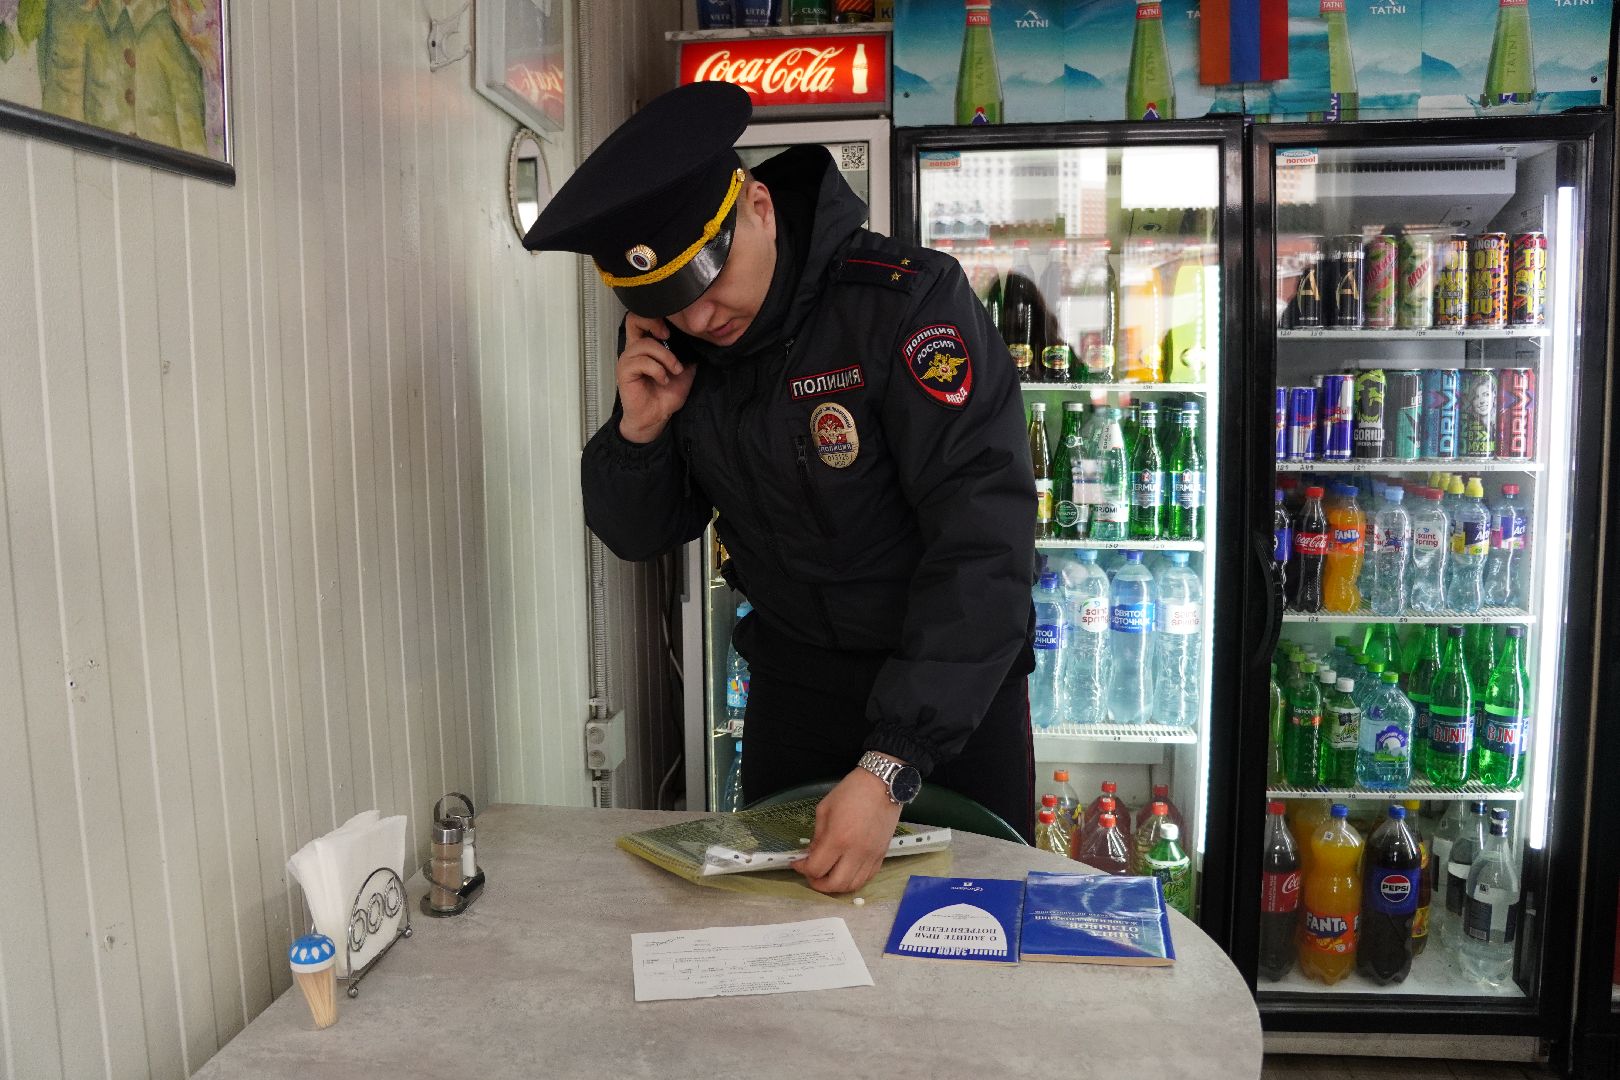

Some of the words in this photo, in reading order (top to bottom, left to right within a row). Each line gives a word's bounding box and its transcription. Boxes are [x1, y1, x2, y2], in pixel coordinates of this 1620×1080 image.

[1138, 8, 1159, 16] TATNI
[1370, 6, 1406, 14] TATNI
[968, 15, 988, 23] TATNI
[1015, 20, 1049, 28] TATNI
[694, 47, 845, 94] Coca-Cola
[1286, 156, 1316, 164] norcool
[906, 327, 956, 356] ПОЛИЦИЯ
[917, 340, 955, 364] РОССИЯ
[792, 368, 861, 397] ПОЛИЦИЯ
[946, 386, 968, 404] МВД
[1440, 374, 1457, 453] DRIVE
[1511, 373, 1527, 453] DRIVE
[820, 444, 852, 453] ПОЛИЦИЯ
[1335, 529, 1360, 540] FANTA
[1295, 534, 1328, 549] Coca-Cola
[1415, 539, 1439, 547] spring
[1433, 725, 1466, 744] BJNI
[1382, 883, 1409, 892] PEPSI
[1306, 911, 1348, 933] FANTA
[918, 925, 998, 935] ПОТРЕБИТЕЛЕЙ
[915, 932, 941, 940] ПРАВ
[944, 934, 985, 942] ЗАЩИТЕ
[938, 944, 968, 956] ЗАКОН
